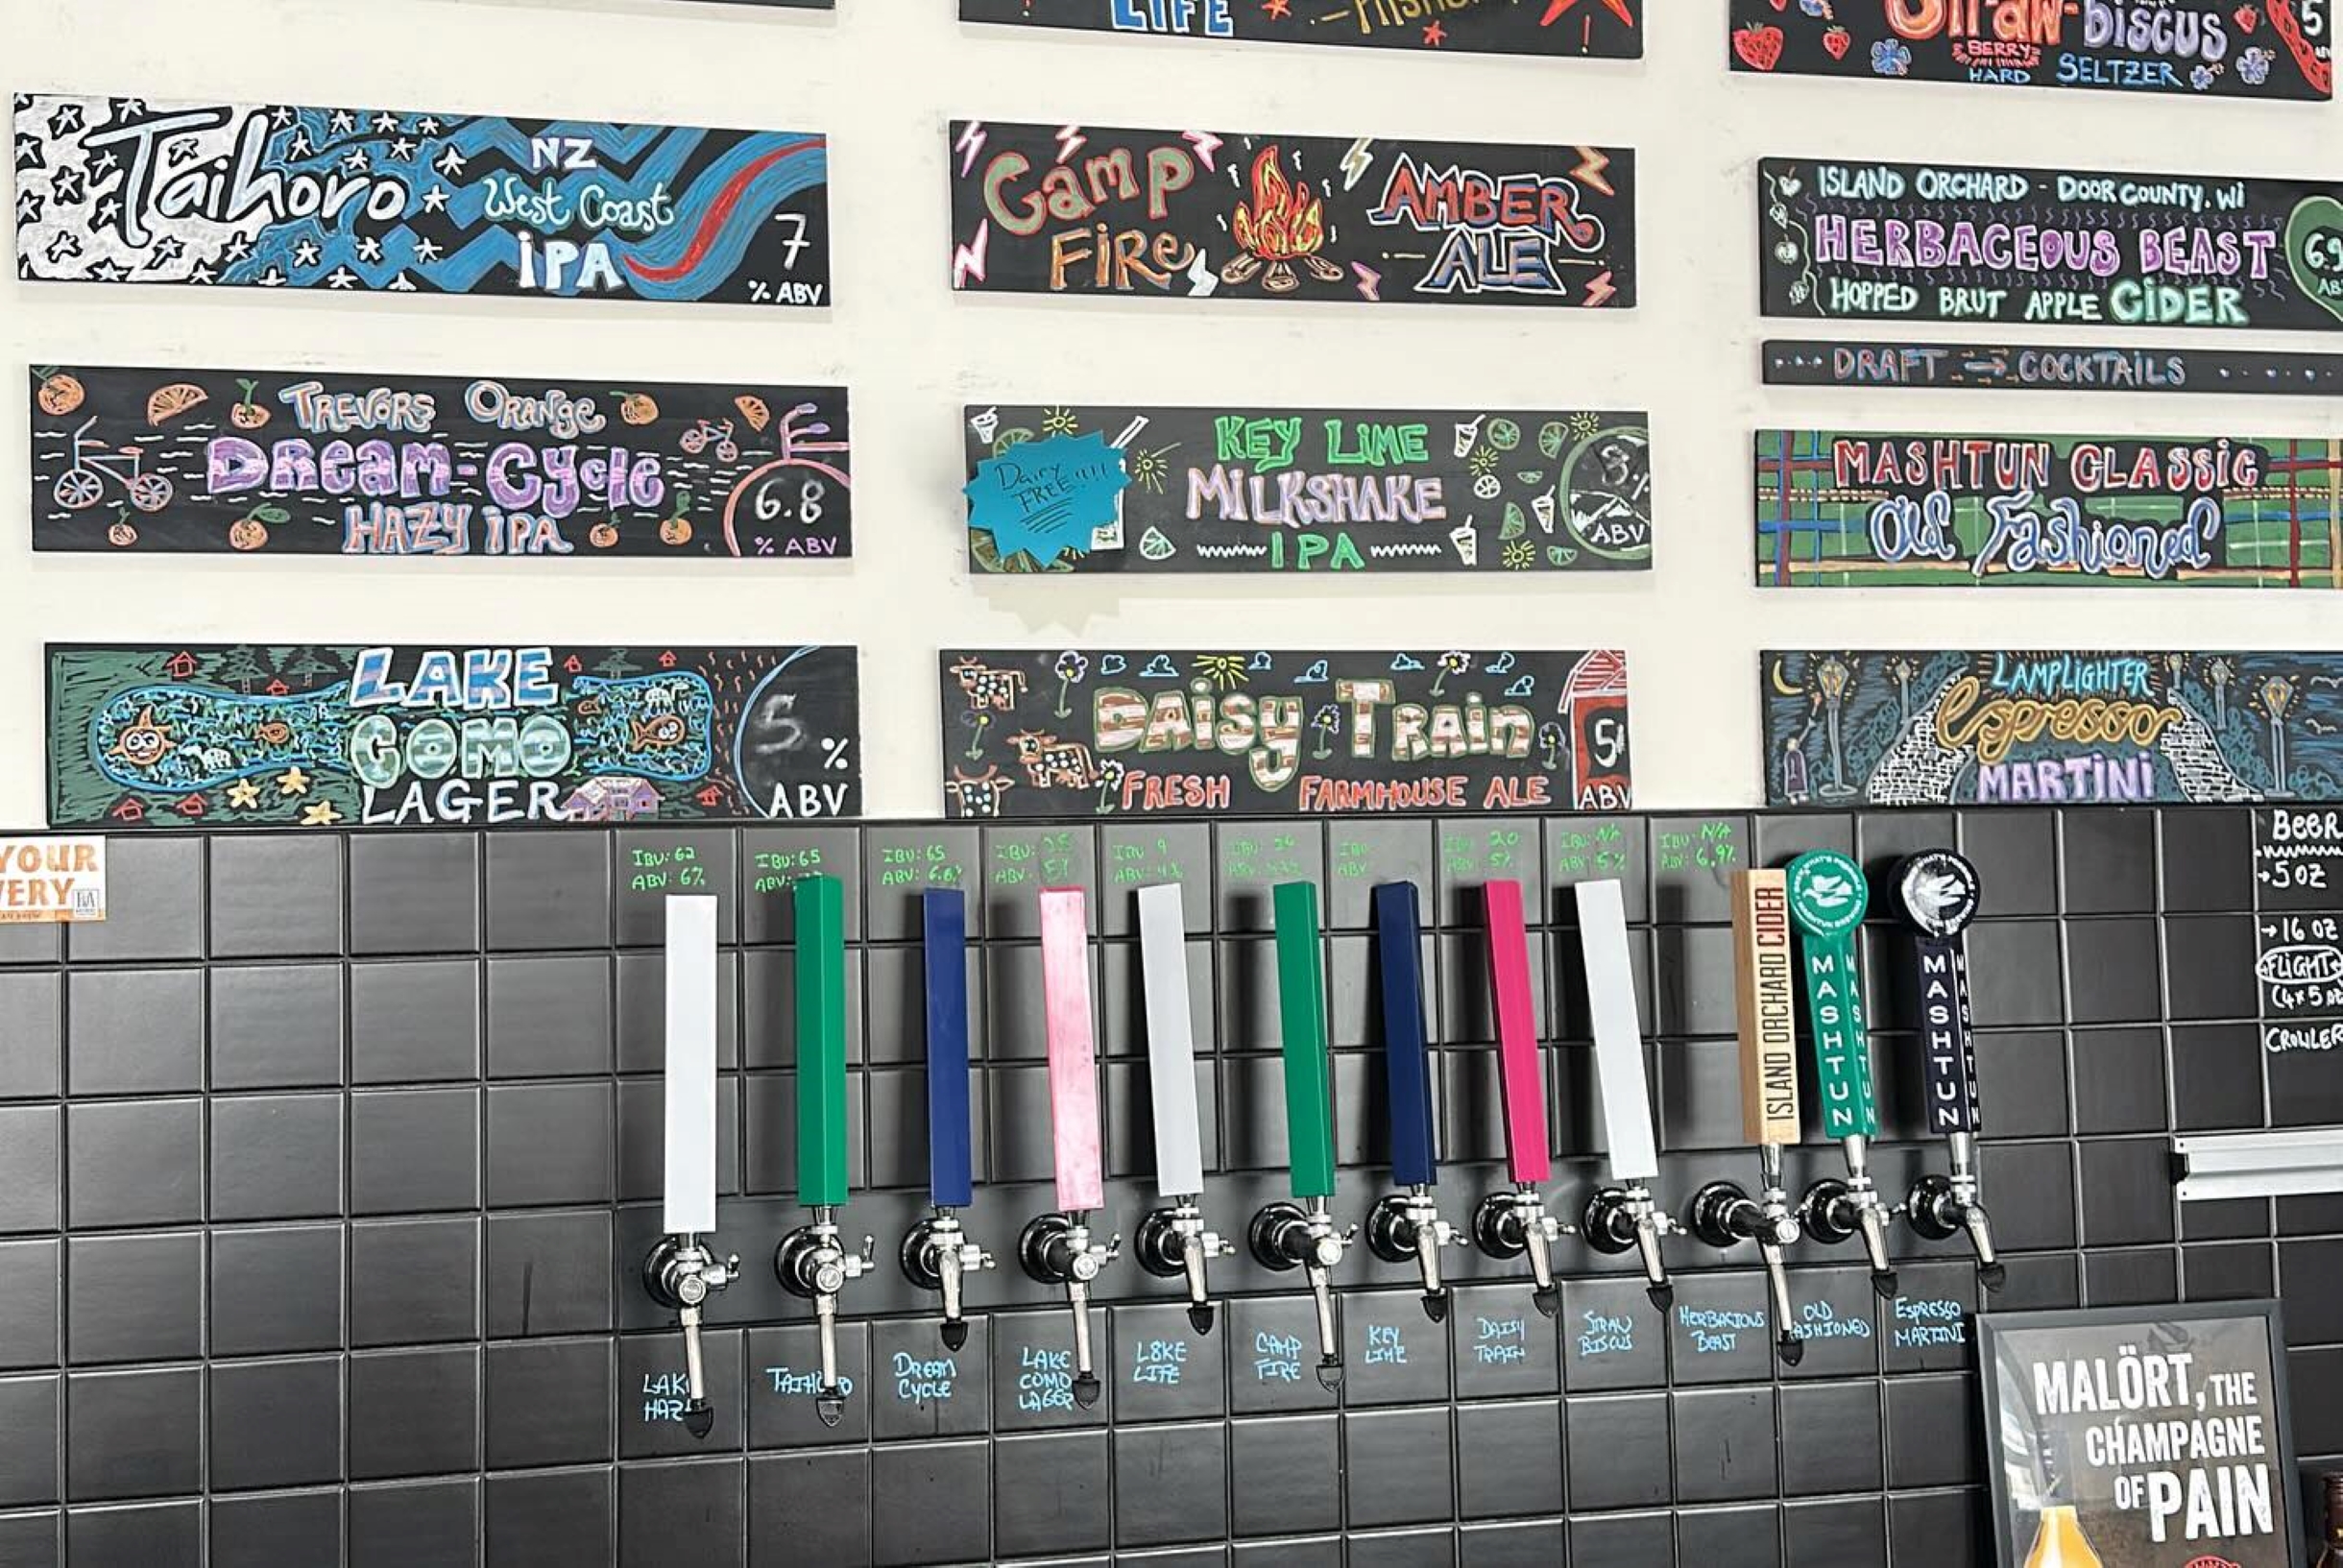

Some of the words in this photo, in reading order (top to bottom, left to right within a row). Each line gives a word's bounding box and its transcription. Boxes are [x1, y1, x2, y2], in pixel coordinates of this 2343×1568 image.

[1968, 40, 2031, 58] BERRY
[1969, 67, 2030, 84] HARD
[2056, 52, 2184, 87] SELTZER
[531, 137, 597, 169] NZ
[84, 112, 407, 248] Taihoro
[1818, 165, 1906, 201] ISLAND
[1916, 167, 2029, 204] ORCHARD
[2058, 176, 2116, 202] DOOR
[483, 178, 570, 227] West
[579, 181, 674, 231] Coast
[1369, 157, 1600, 250] AMBER
[774, 214, 810, 270] 7
[1815, 214, 2120, 277] HERBACEOUS
[2139, 226, 2276, 279] BEAST
[1420, 230, 1562, 292] ALE
[748, 280, 771, 302] %
[776, 282, 824, 305] ABV
[1829, 277, 1920, 313] HOPPED
[1938, 286, 2008, 319] BRUT
[2024, 289, 2103, 321] APPLE
[2318, 277, 2343, 297] AB
[1833, 347, 1948, 382] DRAFT
[1215, 415, 1303, 473] KEY
[1832, 439, 2051, 493] MASHTUN
[755, 478, 825, 524] 6.8
[342, 501, 472, 554] HAZY
[1590, 522, 1646, 544] ABV
[1871, 490, 1956, 562] Old
[1971, 490, 2221, 578] Fashioned
[755, 538, 775, 555] %
[785, 536, 838, 555] ABV
[1269, 532, 1365, 569] IPA
[350, 646, 559, 711] LAKE
[756, 694, 803, 754] 5
[821, 736, 849, 769] %
[350, 714, 571, 789] COMO
[362, 779, 568, 824] LAGER
[769, 783, 849, 817] ABV
[1122, 770, 1231, 810] FRESH
[1299, 775, 1468, 811] FARMHOUSE
[1484, 776, 1552, 808] ALE
[1580, 784, 1631, 809] ABV
[674, 846, 696, 862] 62
[926, 844, 946, 861] 65
[1489, 829, 1520, 848] 20
[799, 849, 821, 866] 65
[0, 878, 75, 905] ERY
[1755, 886, 1785, 948] CIDER
[2283, 916, 2305, 942] 16
[1759, 953, 1790, 1042] ORCHARD
[1811, 955, 1853, 1127] MASHTUN
[1923, 954, 1960, 1127] MASHTUN
[1765, 1052, 1794, 1121] ISLAND
[1803, 1300, 1834, 1321] OLD
[1368, 1324, 1401, 1348] KEY
[1475, 1316, 1526, 1341] DAISY
[1578, 1333, 1633, 1357] BISCUS
[1690, 1329, 1737, 1353] BEAST
[1790, 1317, 1872, 1340] ASHIONED
[1894, 1321, 1967, 1348] MARTINI
[1022, 1346, 1072, 1371] LAKE
[1255, 1331, 1302, 1361] CAMP
[1365, 1344, 1408, 1364] LIME
[1472, 1343, 1527, 1364] TRAIN
[643, 1372, 689, 1396] LAK
[1020, 1373, 1073, 1390] COMO
[1133, 1363, 1181, 1385] LIFE
[1254, 1358, 1301, 1383] FIRE
[2032, 1344, 2208, 1415] MALÖRT,
[2210, 1372, 2258, 1406] THE
[1019, 1388, 1074, 1411] LAGER
[2085, 1415, 2266, 1467] CHAMPAGNE
[2114, 1475, 2148, 1511] OF
[2148, 1462, 2275, 1543] PAIN
